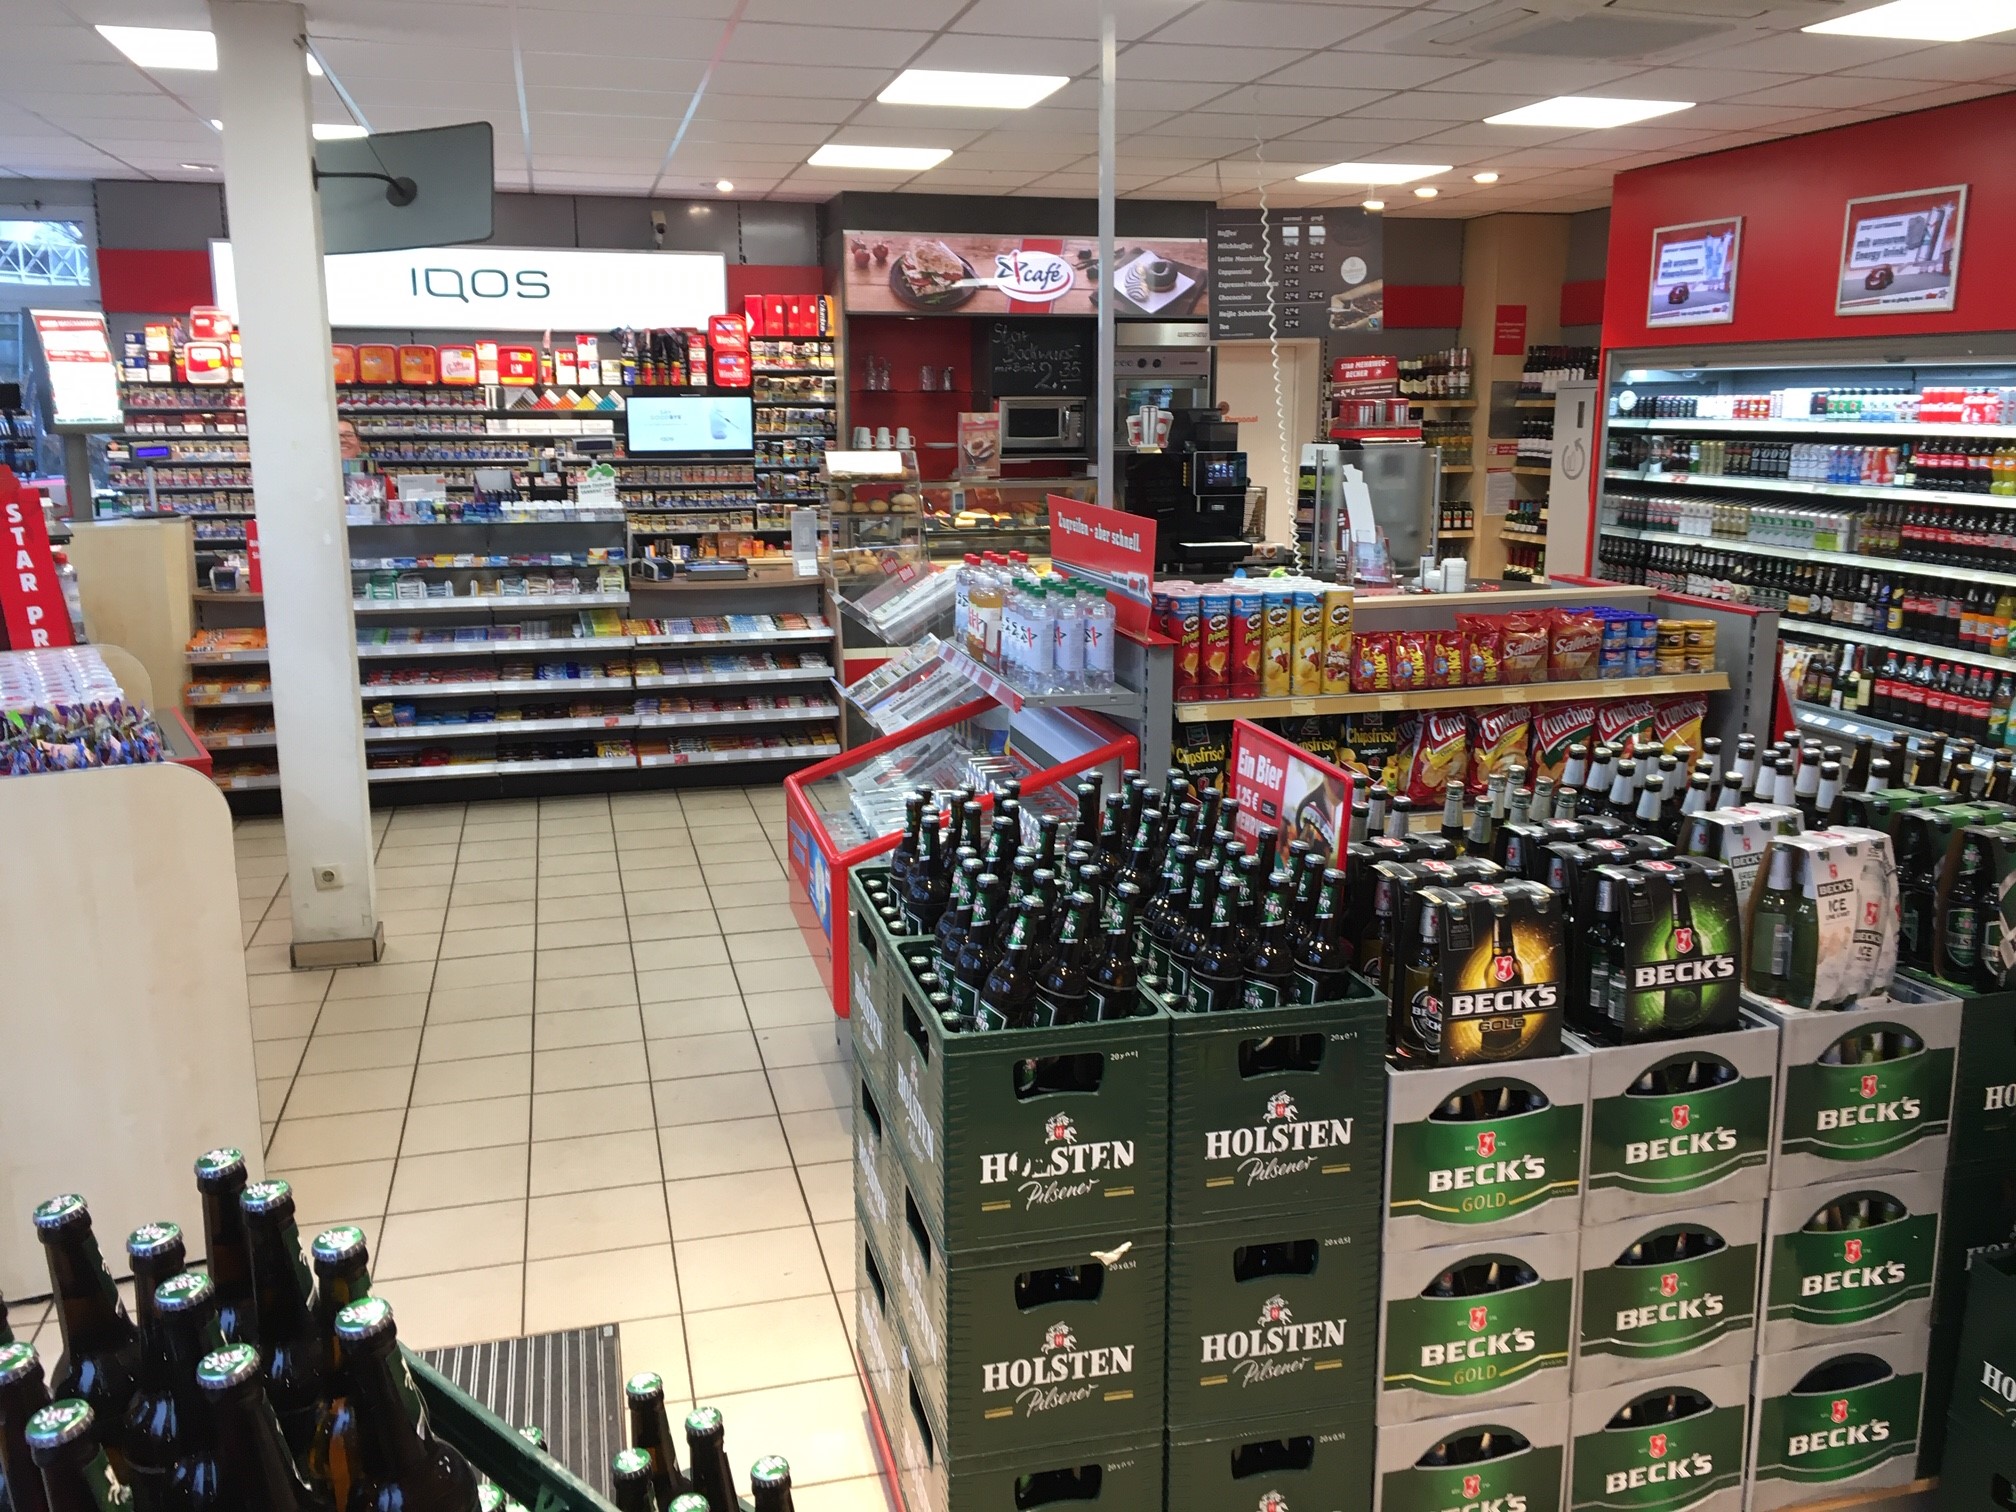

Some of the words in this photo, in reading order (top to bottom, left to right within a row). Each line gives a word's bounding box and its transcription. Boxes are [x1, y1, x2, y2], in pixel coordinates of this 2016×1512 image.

[411, 267, 550, 303] IQOS
[1024, 263, 1063, 290] café
[1094, 522, 1110, 543] aber
[5, 503, 39, 593] STAR
[26, 605, 50, 647] PR
[1237, 746, 1255, 779] Ein
[1256, 755, 1283, 791] Bier
[1818, 880, 1853, 896] BECK'S
[1829, 899, 1847, 912] ICE
[1634, 955, 1735, 988] BECK'S
[1451, 984, 1557, 1017] BECK'S
[1479, 1017, 1526, 1033] GOLD
[897, 1061, 934, 1164] HOLSTEN
[1816, 1096, 1921, 1132] BECK'S
[1205, 1117, 1354, 1160] HOLSTEN
[1625, 1126, 1738, 1165] BECK'S
[1237, 1155, 1318, 1187] Pilsener
[1427, 1154, 1546, 1194] BECK'S
[1017, 1177, 1100, 1211] Pilsener
[1461, 1192, 1507, 1213] GOLD
[1801, 1261, 1906, 1297] BECK'S
[1615, 1292, 1724, 1332] BECK'S
[1199, 1318, 1348, 1363] HOLSTEN
[1420, 1327, 1536, 1368] BECK'S
[982, 1345, 1135, 1393] HOLSTEN
[1232, 1354, 1312, 1389] Pilsener
[1453, 1364, 1497, 1386] GOLD
[1015, 1383, 1098, 1418] Pilsener
[1787, 1418, 1890, 1457] BECK'S
[1605, 1452, 1714, 1494] BECK'S
